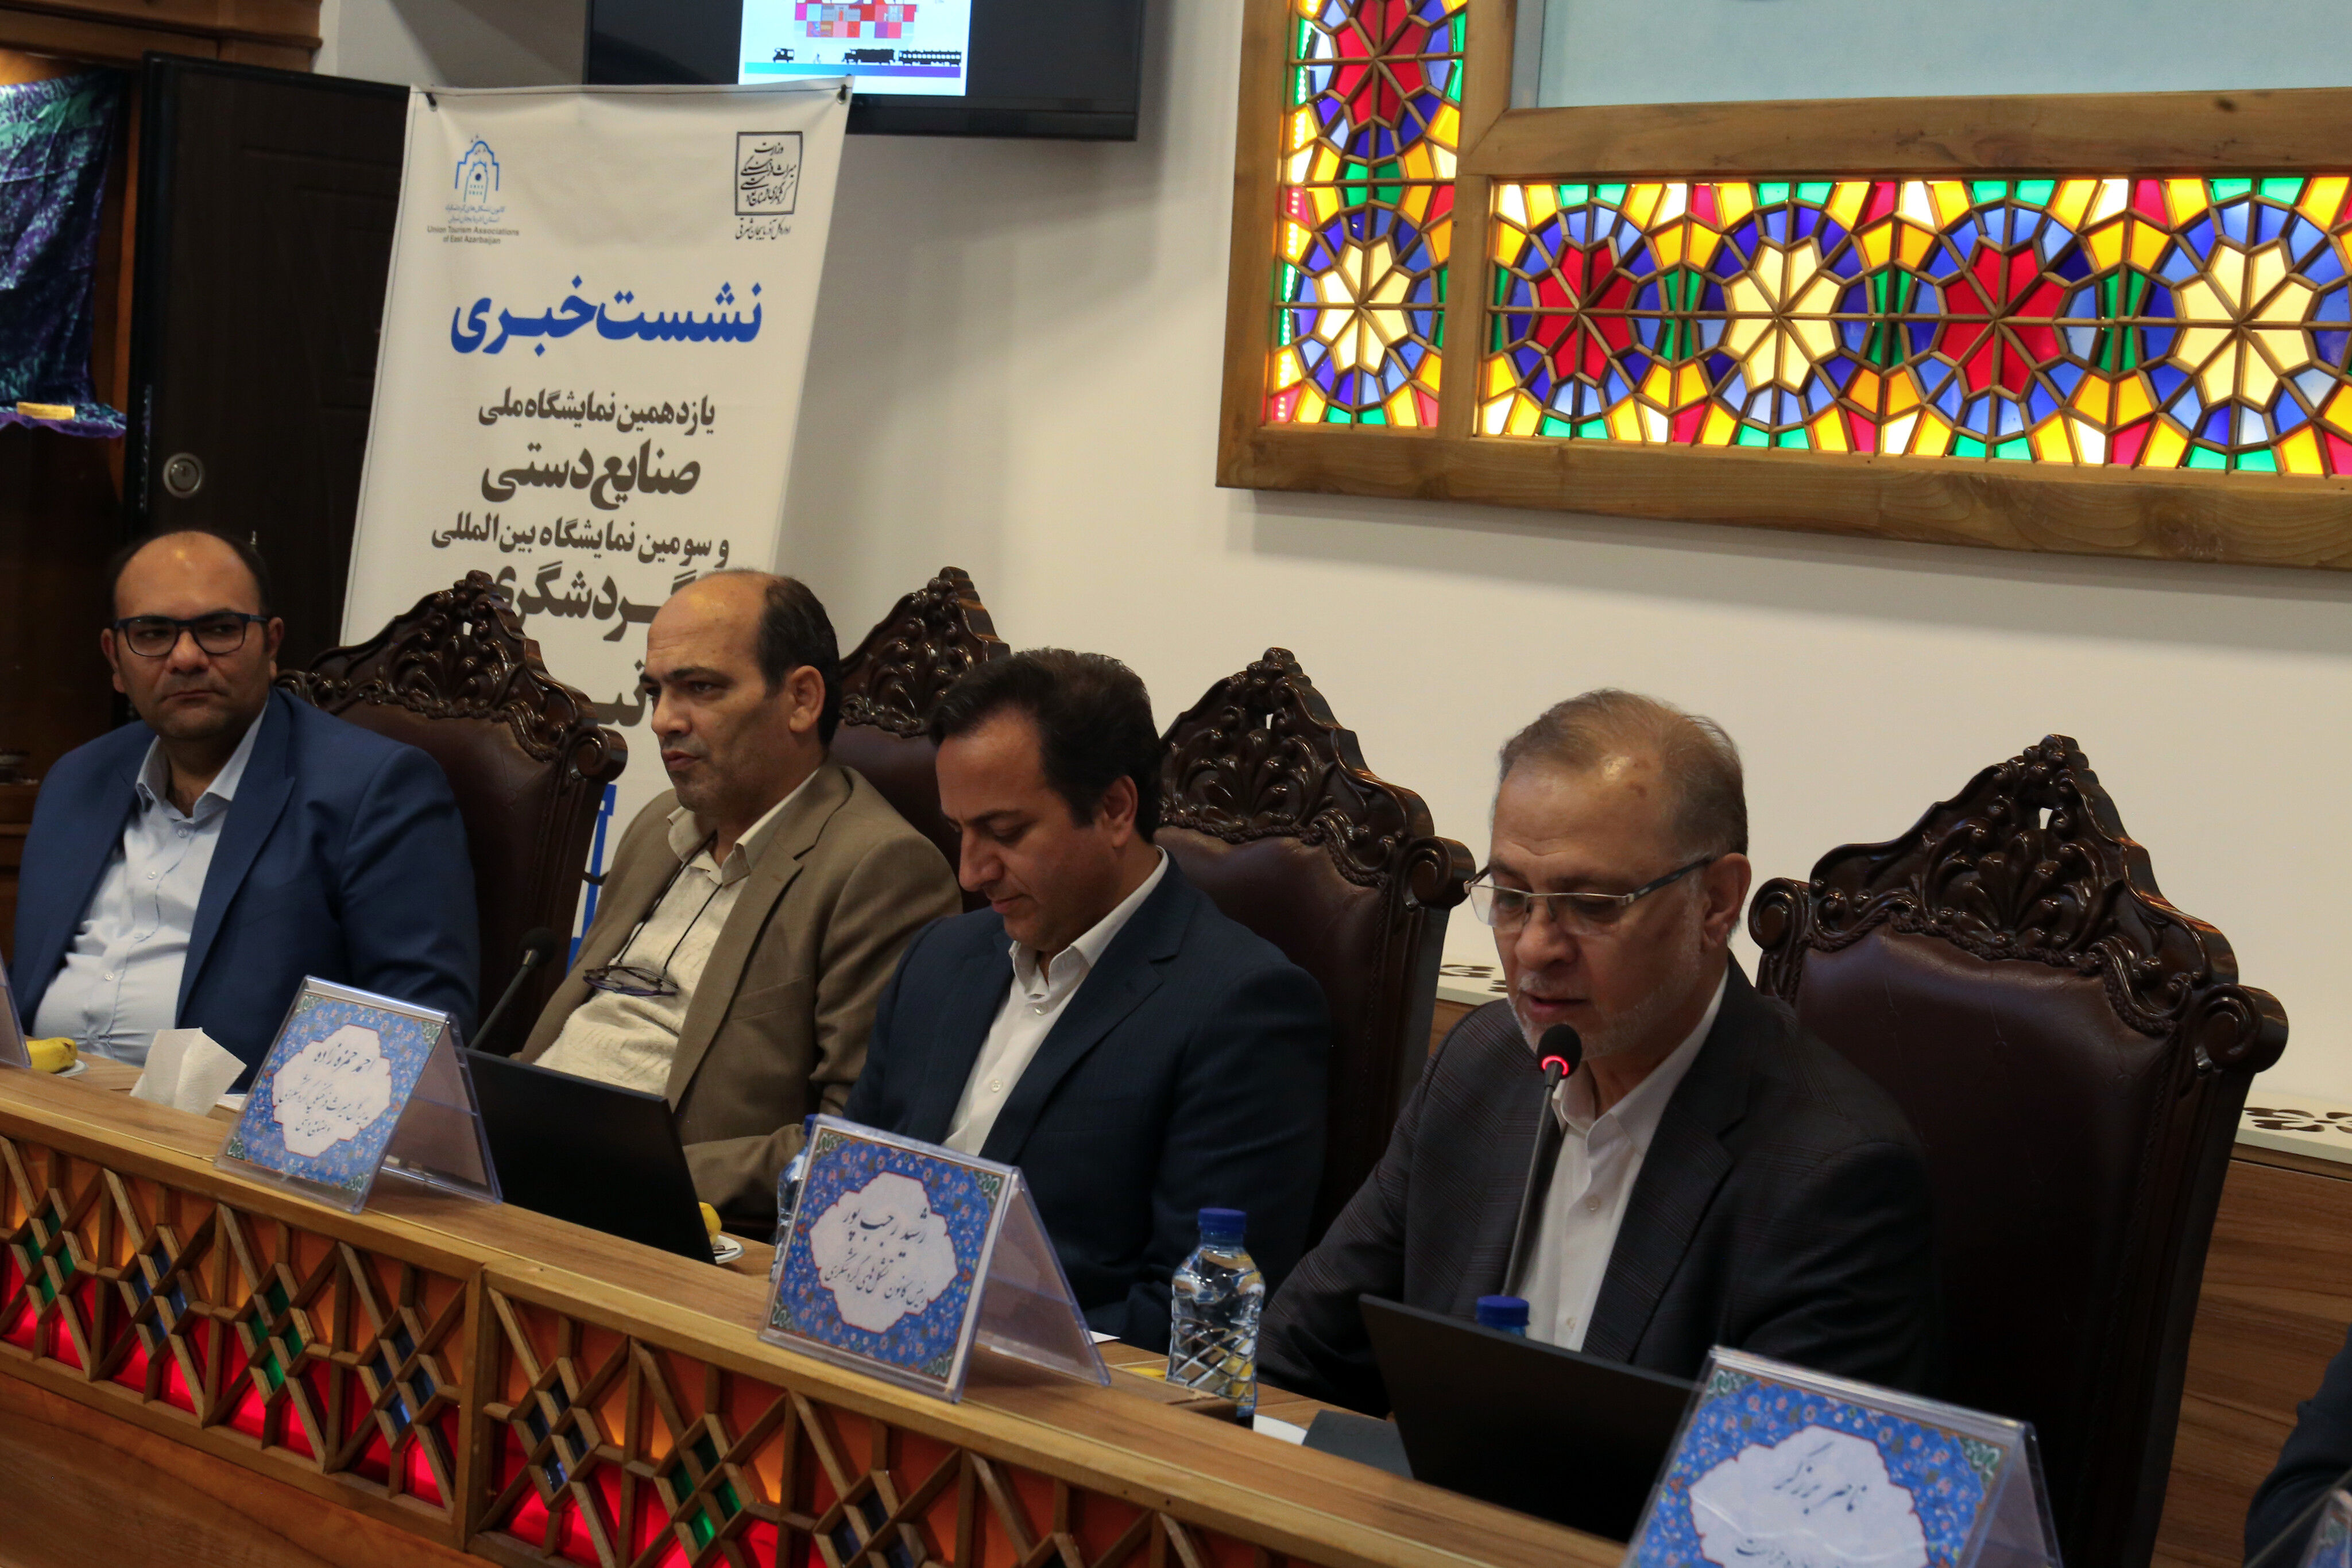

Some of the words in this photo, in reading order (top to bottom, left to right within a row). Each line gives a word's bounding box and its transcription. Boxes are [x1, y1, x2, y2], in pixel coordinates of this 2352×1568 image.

[473, 226, 520, 237] Associations
[450, 275, 598, 357] خبری
[596, 282, 762, 343] نشست
[478, 386, 524, 427] ملی
[524, 388, 616, 428] نمایشگاه
[617, 394, 715, 436] یازدهمین
[481, 442, 595, 503] دستی
[589, 438, 701, 511] صنایع
[539, 517, 636, 559] نمایشگاه
[637, 534, 712, 566] سومین
[713, 539, 729, 568] و
[860, 1214, 899, 1248] رجب
[898, 1207, 928, 1258] رشید
